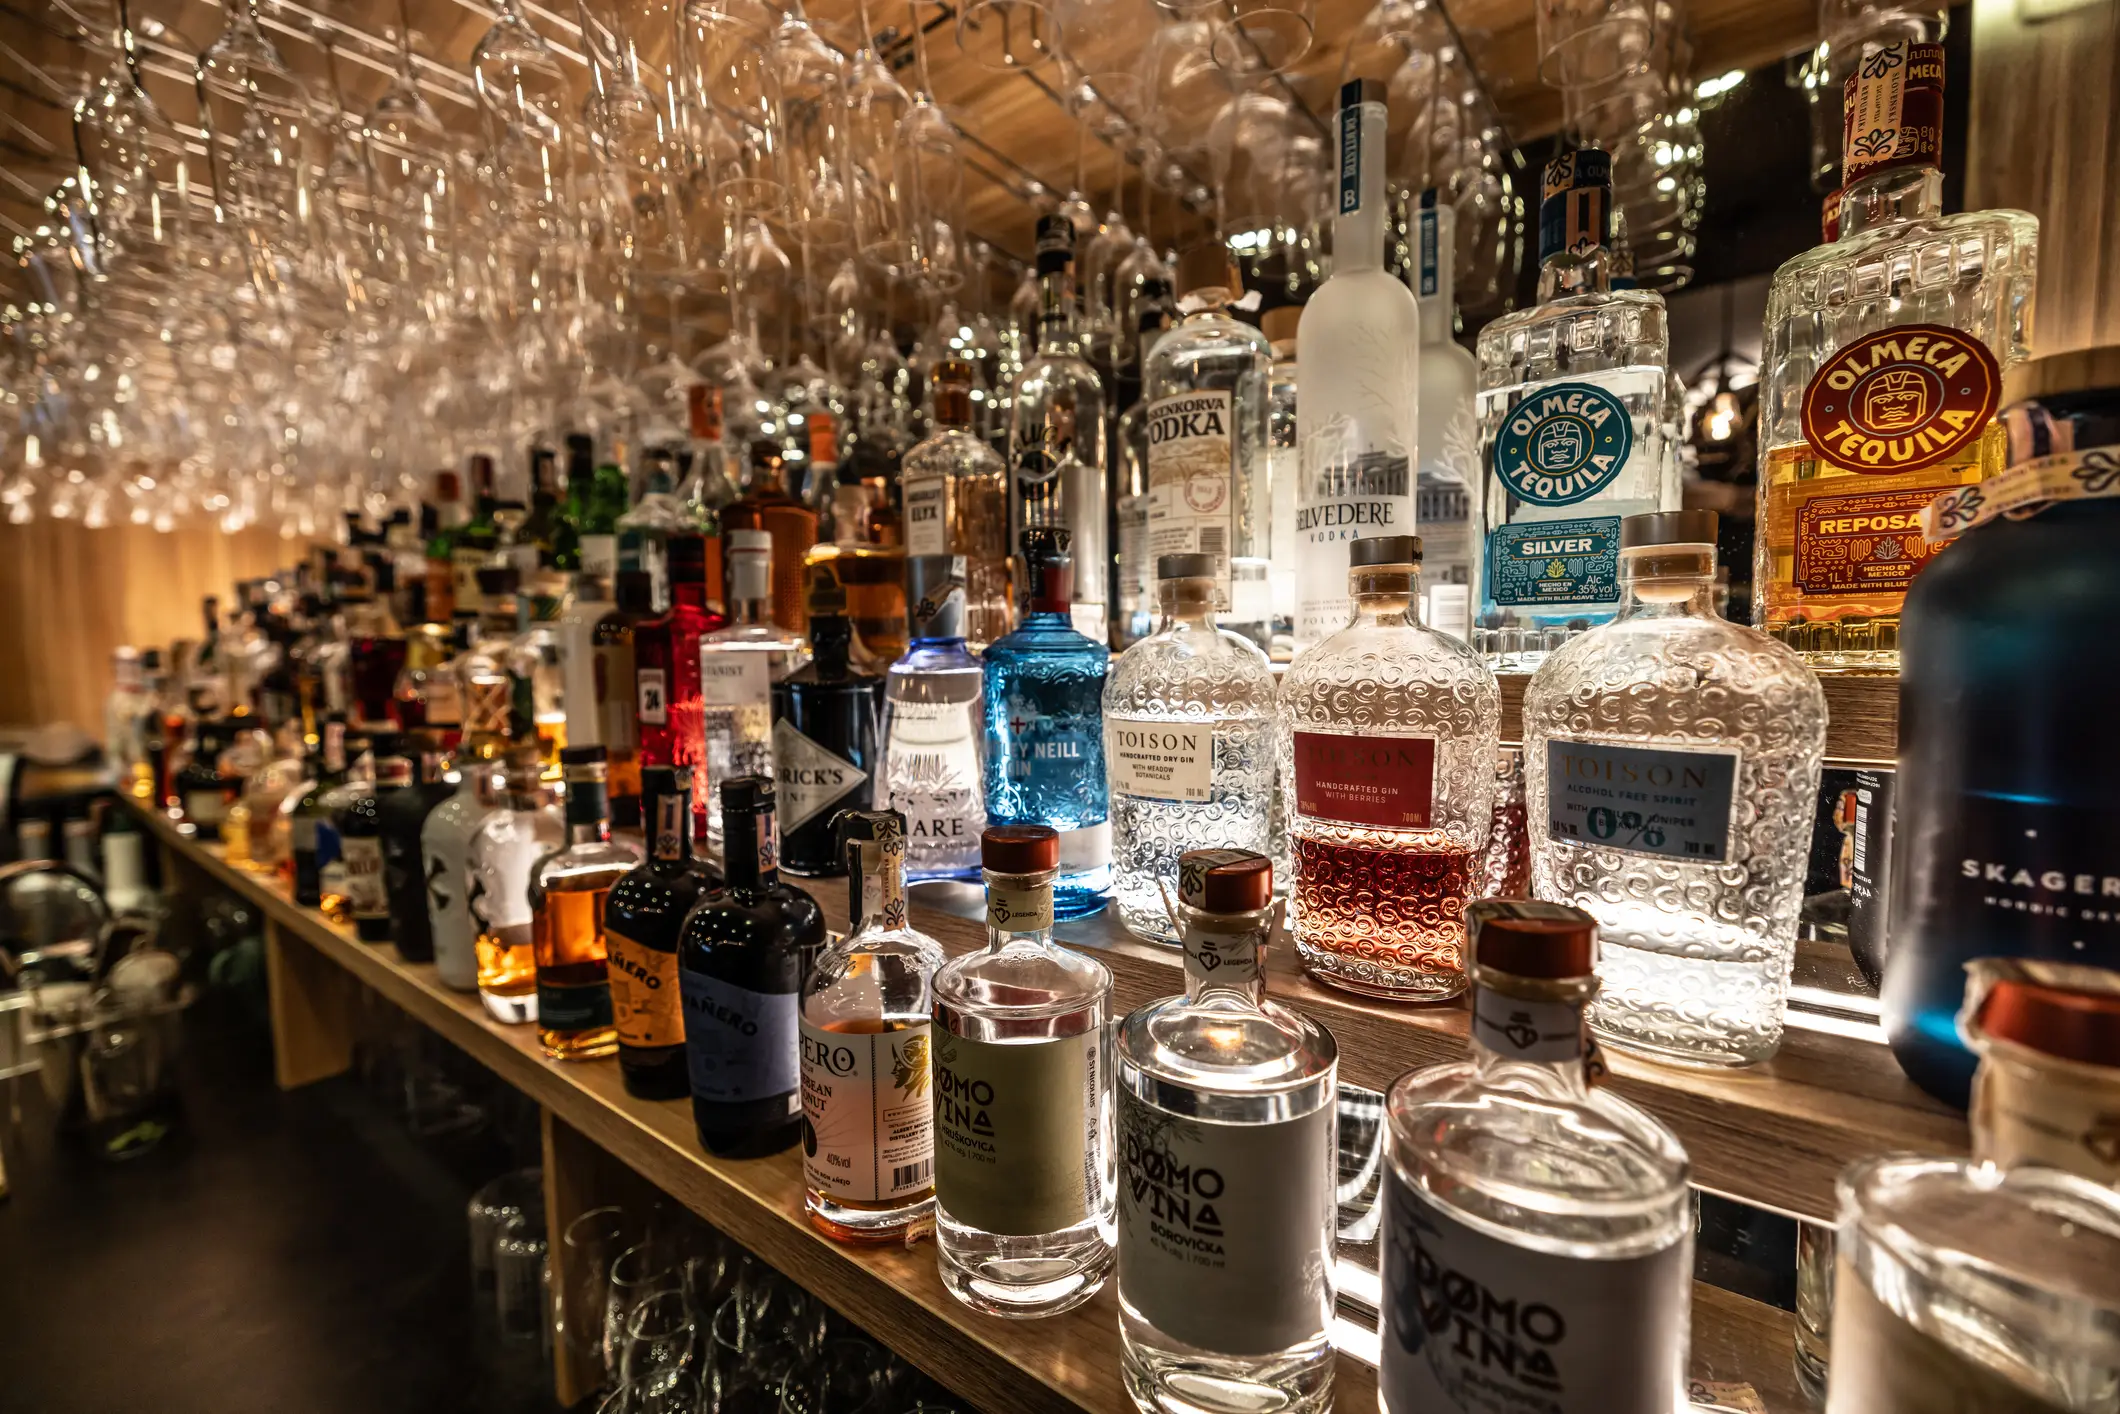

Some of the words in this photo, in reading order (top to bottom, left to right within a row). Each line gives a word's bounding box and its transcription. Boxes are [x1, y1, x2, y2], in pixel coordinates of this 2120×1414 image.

[1907, 63, 1942, 81] MECA
[1827, 336, 1971, 390] OLMECA
[1511, 393, 1612, 437] OLMECA
[1824, 407, 1976, 464] TEQUILA
[1510, 453, 1615, 498] TEQUILA
[1310, 528, 1360, 543] VODKA
[1521, 538, 1593, 555] SILVER
[1863, 565, 1894, 573] HECHO
[1868, 570, 1906, 578] MEXICO
[1586, 575, 1604, 584] Alc.
[1828, 572, 1842, 583] 1L
[1884, 580, 1909, 588] BLUE
[1514, 587, 1525, 597] 1L
[1578, 584, 1598, 594] 35%
[1598, 583, 1613, 594] vol
[1303, 612, 1353, 626] POLAN
[1117, 730, 1198, 751] TOISON
[1034, 741, 1081, 759] NEILL
[1120, 752, 1161, 762] HANDCRAFTED
[1163, 755, 1178, 763] DRY
[1132, 763, 1146, 772] WITH
[1147, 764, 1174, 774] MEADOW
[1561, 754, 1708, 789] TOISON
[1135, 771, 1171, 781] BOTANICALS
[1316, 780, 1378, 794] HANDCRAFTED
[1381, 787, 1399, 795] GIN
[1325, 791, 1346, 800] WITH
[1349, 793, 1387, 804] BERRIES
[1567, 784, 1614, 798] ALCOHOL
[1619, 790, 1648, 801] FREE
[1653, 793, 1697, 807] SPIRIT
[1566, 802, 1588, 814] WITH
[889, 1131, 918, 1142] DISTILLERY
[893, 1125, 913, 1135] ALBERT
[941, 1125, 996, 1153] HRUŠKOVICA
[1151, 1221, 1225, 1256] BOROVIČKA
